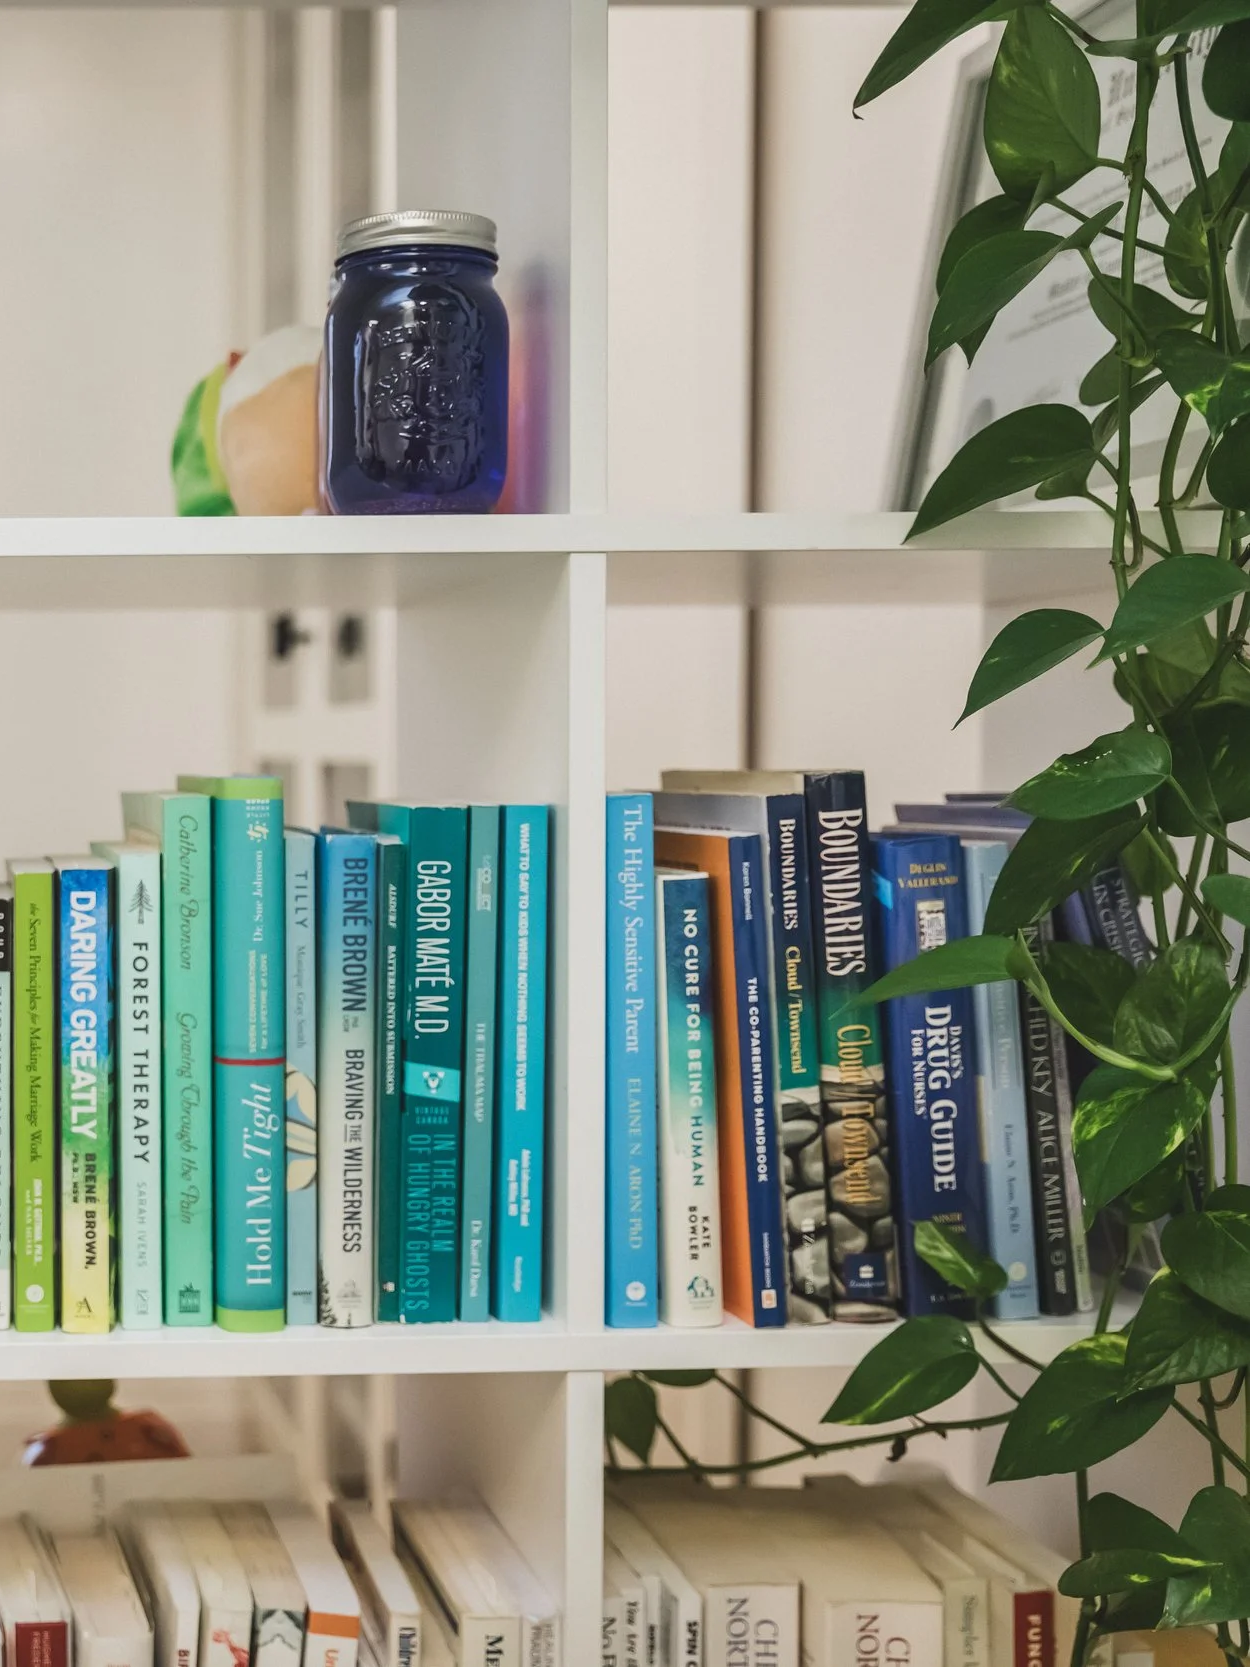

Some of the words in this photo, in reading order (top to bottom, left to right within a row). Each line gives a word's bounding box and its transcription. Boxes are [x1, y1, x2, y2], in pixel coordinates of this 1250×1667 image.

[519, 823, 530, 856] WHAT
[624, 804, 644, 842] The
[177, 814, 199, 896] Catherine
[252, 850, 263, 898] Johnson
[519, 855, 529, 870] TO
[618, 848, 645, 910] Highly
[741, 861, 752, 886] Karen
[778, 818, 799, 930] BOUNDARIES
[294, 870, 309, 929] TILLY
[342, 857, 373, 927] BRENÉ
[416, 860, 452, 932] GABOR
[519, 872, 529, 896] SAY
[519, 895, 529, 909] TO
[817, 807, 867, 976] BOUNDARIES
[29, 918, 41, 951] Seven
[179, 899, 200, 970] Bronson
[253, 900, 263, 922] Sue
[518, 911, 529, 936] KIDS
[682, 909, 698, 938] NO
[70, 889, 98, 1003] DARING
[415, 938, 455, 989] MATÉ
[518, 937, 529, 971] WHEN
[624, 916, 646, 992] Sensitive
[683, 944, 700, 997] CURE
[26, 955, 42, 1010] Principles
[133, 942, 150, 1035] FOREST
[341, 934, 367, 1012] BROWN
[385, 945, 397, 1000] BATTERED
[516, 972, 528, 1022] NOTHING
[747, 977, 759, 1003] THE
[295, 1019, 307, 1049] Smith
[385, 1002, 397, 1030] INTO
[415, 996, 450, 1040] M.D.
[625, 997, 645, 1054] Parent
[685, 1003, 701, 1042] FOR
[26, 1027, 41, 1073] Making
[385, 1031, 397, 1095] SUBMISSION
[516, 1024, 528, 1062] SEEMS
[748, 1006, 764, 1105] CO-PARENTING
[910, 1029, 924, 1057] FOR
[923, 1004, 953, 1090] DRUG
[70, 1008, 98, 1140] GREATLY
[344, 1048, 365, 1121] BRAVING
[515, 1078, 528, 1111] WORK
[516, 1062, 527, 1077] TO
[688, 1048, 703, 1108] BEING
[25, 1076, 42, 1127] Marriage
[132, 1049, 150, 1164] THERAPY
[241, 1083, 281, 1160] Tight
[626, 1077, 642, 1137] ELAINE
[29, 1129, 43, 1163] Work
[349, 1123, 362, 1143] THE
[406, 1133, 432, 1155] OF
[432, 1133, 456, 1150] IN
[690, 1115, 705, 1187] HUMAN
[753, 1108, 769, 1183] HANDBOOK
[841, 1103, 882, 1207] Townsend
[929, 1099, 958, 1192] GUIDE
[1036, 1111, 1059, 1163] ALICE
[84, 1152, 100, 1204] BRENÉ
[245, 1167, 273, 1209] Me
[342, 1147, 363, 1253] WILDERNESS
[405, 1162, 431, 1231] HUNGRY
[431, 1159, 456, 1189] THE
[136, 1182, 148, 1224] SARAH
[430, 1196, 456, 1252] REALM
[470, 1219, 483, 1237] Dr.
[137, 1229, 148, 1268] IVENS
[245, 1218, 273, 1287] Hold
[688, 1205, 700, 1261] BOWLER
[700, 1215, 712, 1249] KATE
[404, 1240, 430, 1310] GHOSTS
